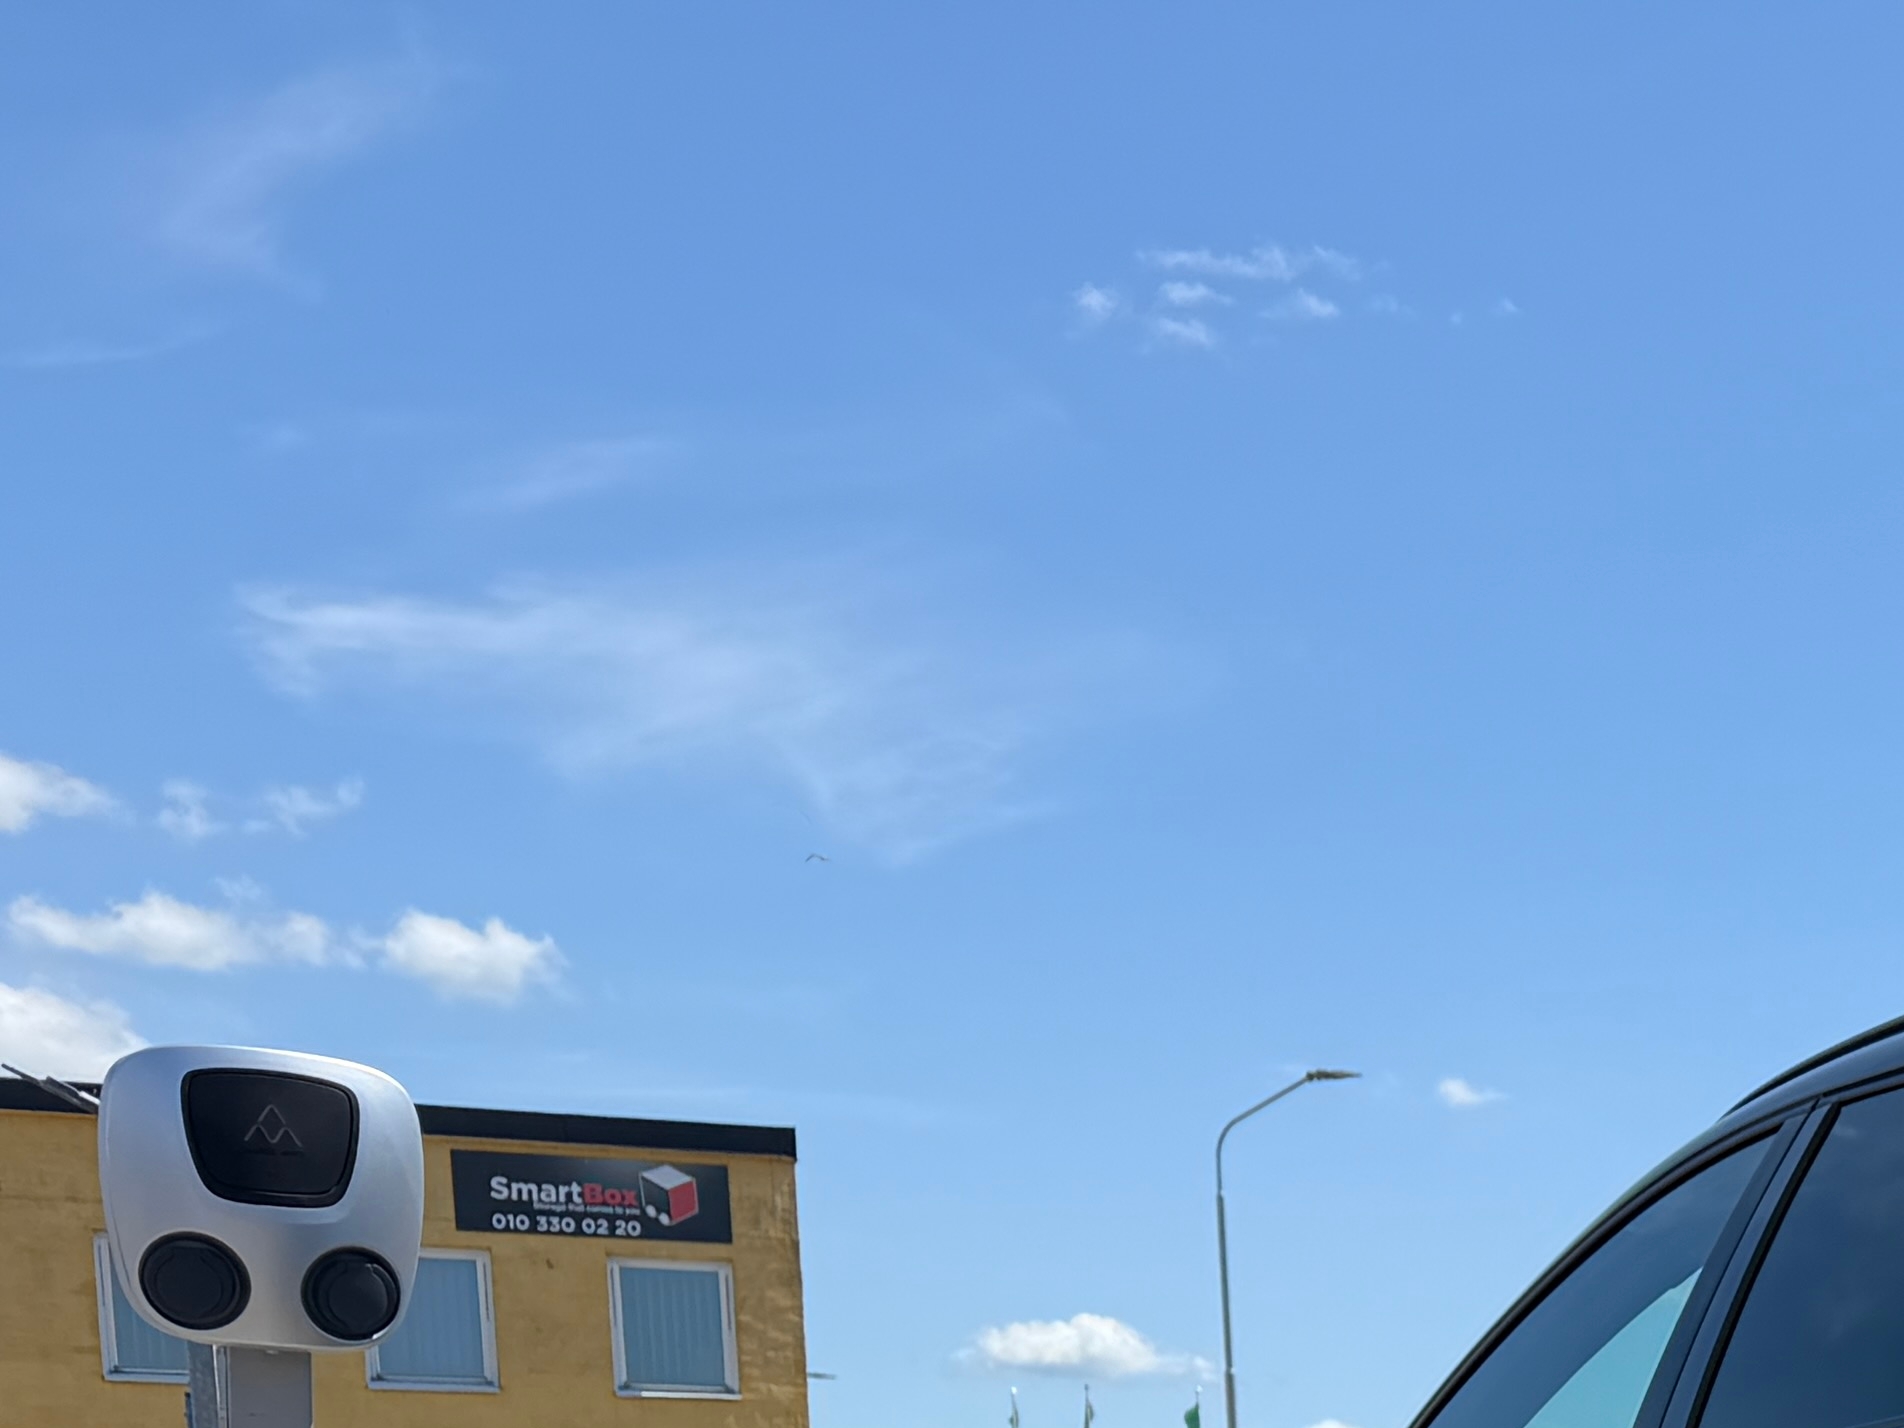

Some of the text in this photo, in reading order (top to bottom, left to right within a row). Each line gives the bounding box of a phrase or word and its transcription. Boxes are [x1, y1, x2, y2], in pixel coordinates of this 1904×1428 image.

[489, 1175, 639, 1207] SmartBox
[491, 1212, 642, 1237] 010 330 02 20
